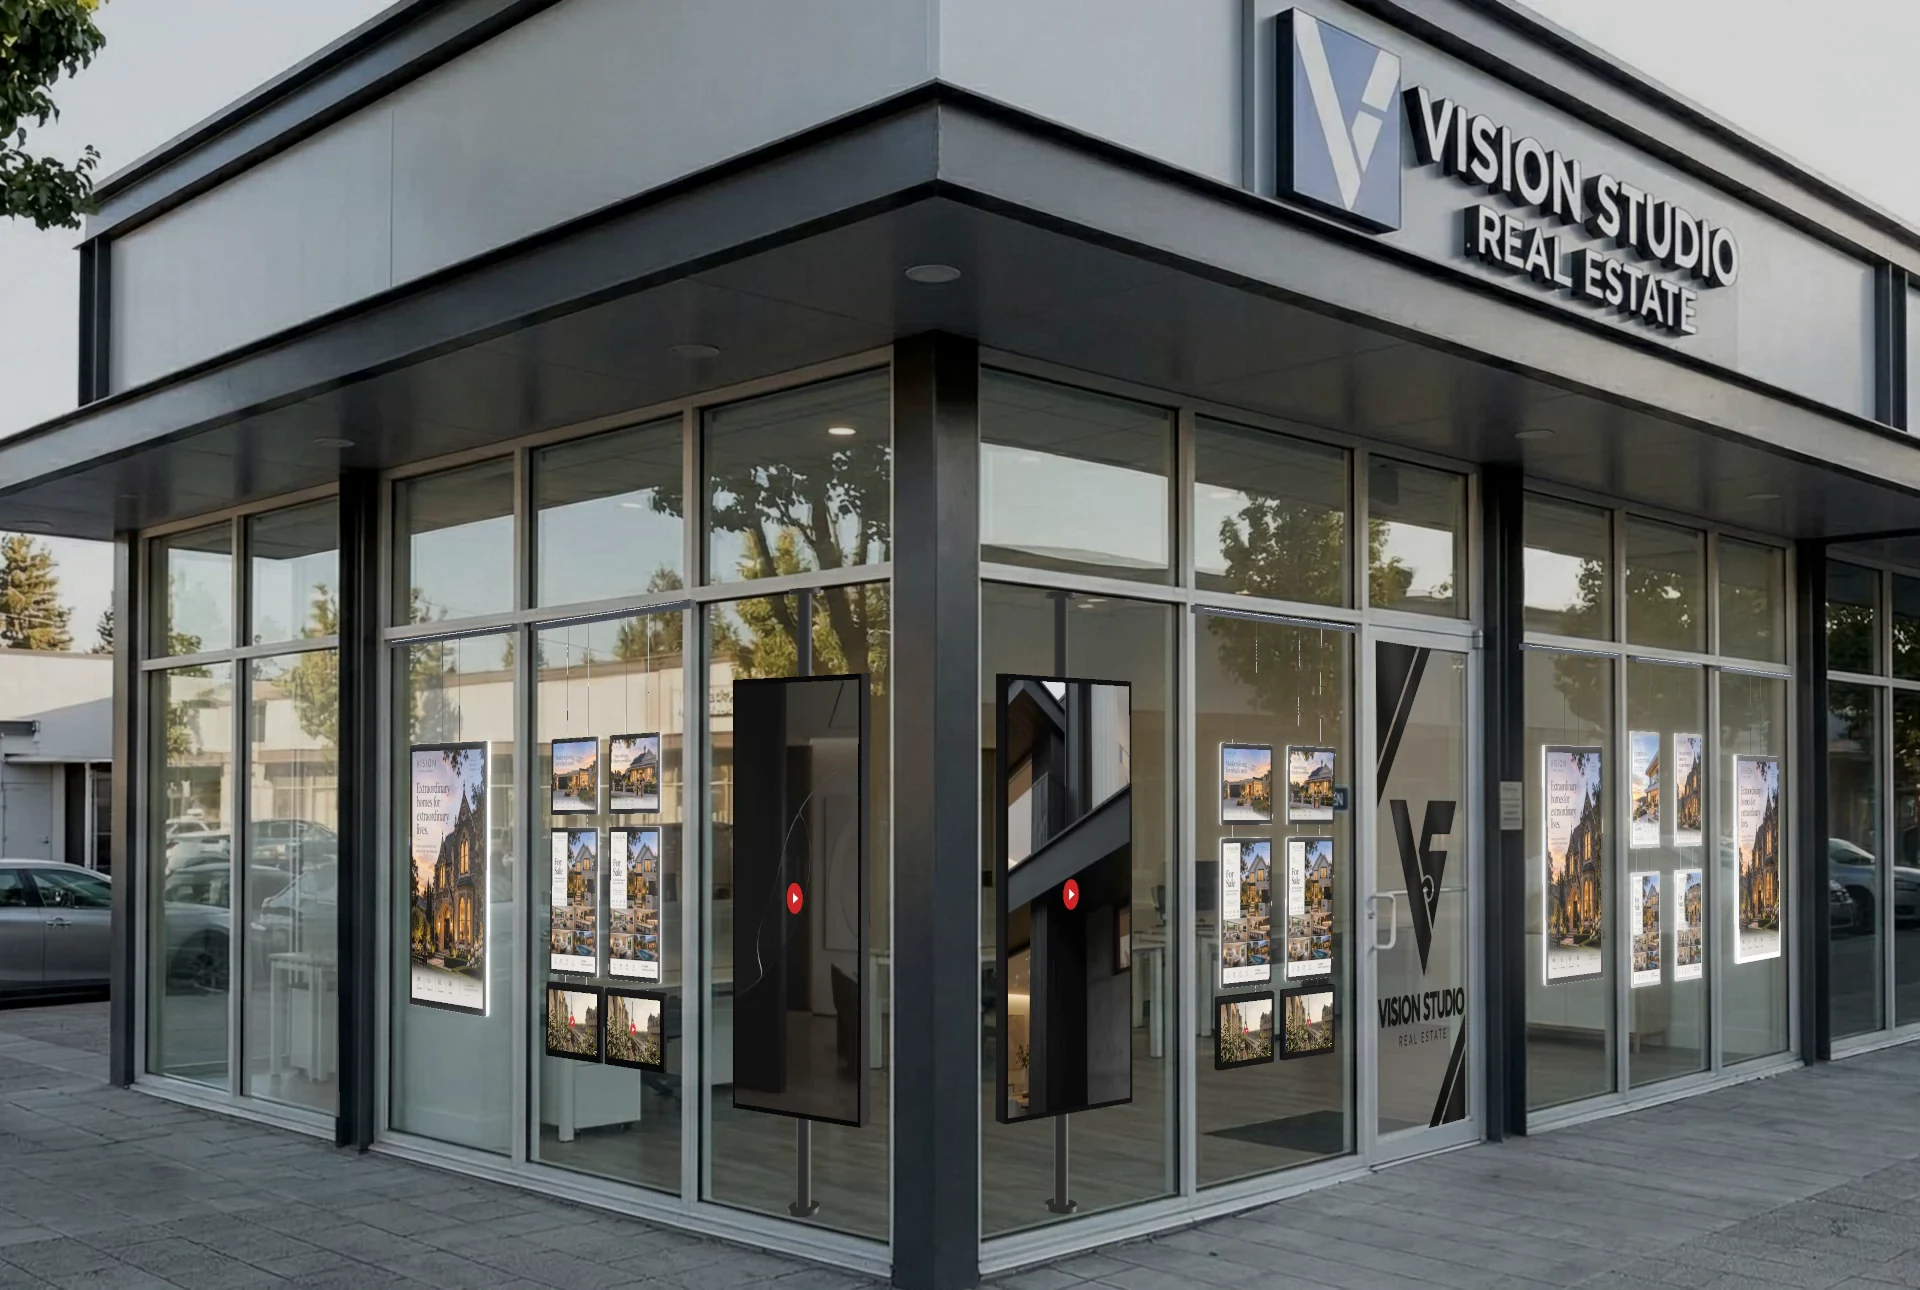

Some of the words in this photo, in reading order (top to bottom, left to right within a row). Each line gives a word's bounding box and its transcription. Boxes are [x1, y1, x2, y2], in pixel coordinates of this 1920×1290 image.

[1416, 85, 1582, 224] VISION
[1597, 173, 1739, 287] STUDIO
[1479, 204, 1573, 288] REAL
[1585, 248, 1698, 334] ESTATE
[416, 759, 437, 768] VISION
[416, 782, 450, 796] Extraordinary
[1550, 781, 1577, 793] Extraordinary
[416, 796, 433, 807] homes
[433, 796, 441, 807] for
[416, 809, 449, 824] extraordinary
[1226, 870, 1235, 879] For
[1291, 868, 1299, 876] For
[1378, 993, 1421, 1029] VISION
[1423, 986, 1465, 1022] STUDIO
[1398, 1033, 1418, 1048] REAL
[1420, 1027, 1447, 1044] ESTATE
